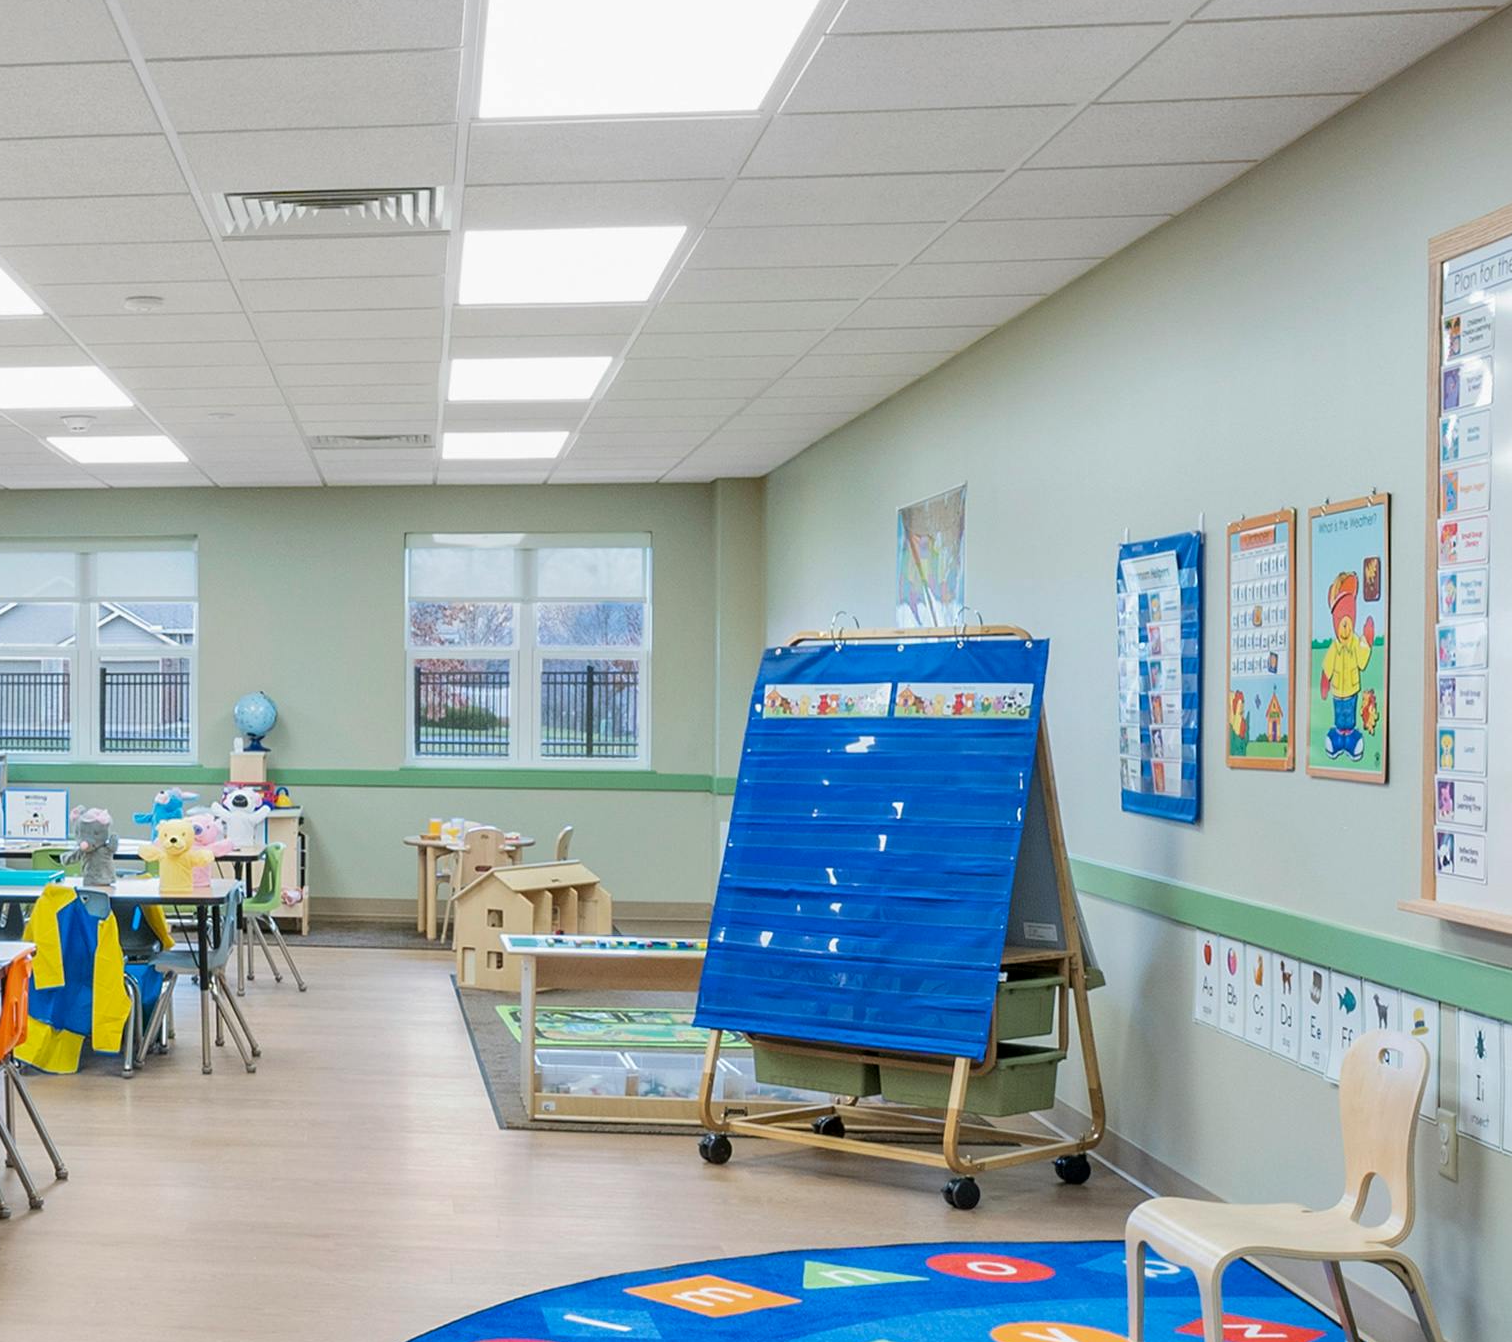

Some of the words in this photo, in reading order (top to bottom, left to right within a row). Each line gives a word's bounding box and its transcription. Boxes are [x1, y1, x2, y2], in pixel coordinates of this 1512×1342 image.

[1455, 272, 1476, 292] Plan
[1480, 263, 1495, 284] for
[1202, 976, 1214, 997] Aa
[1227, 983, 1238, 1006] Bb
[1252, 994, 1264, 1016] Cc
[1280, 1003, 1292, 1028] Dd
[1310, 1015, 1322, 1040] Ee
[1476, 1074, 1484, 1102] Ii
